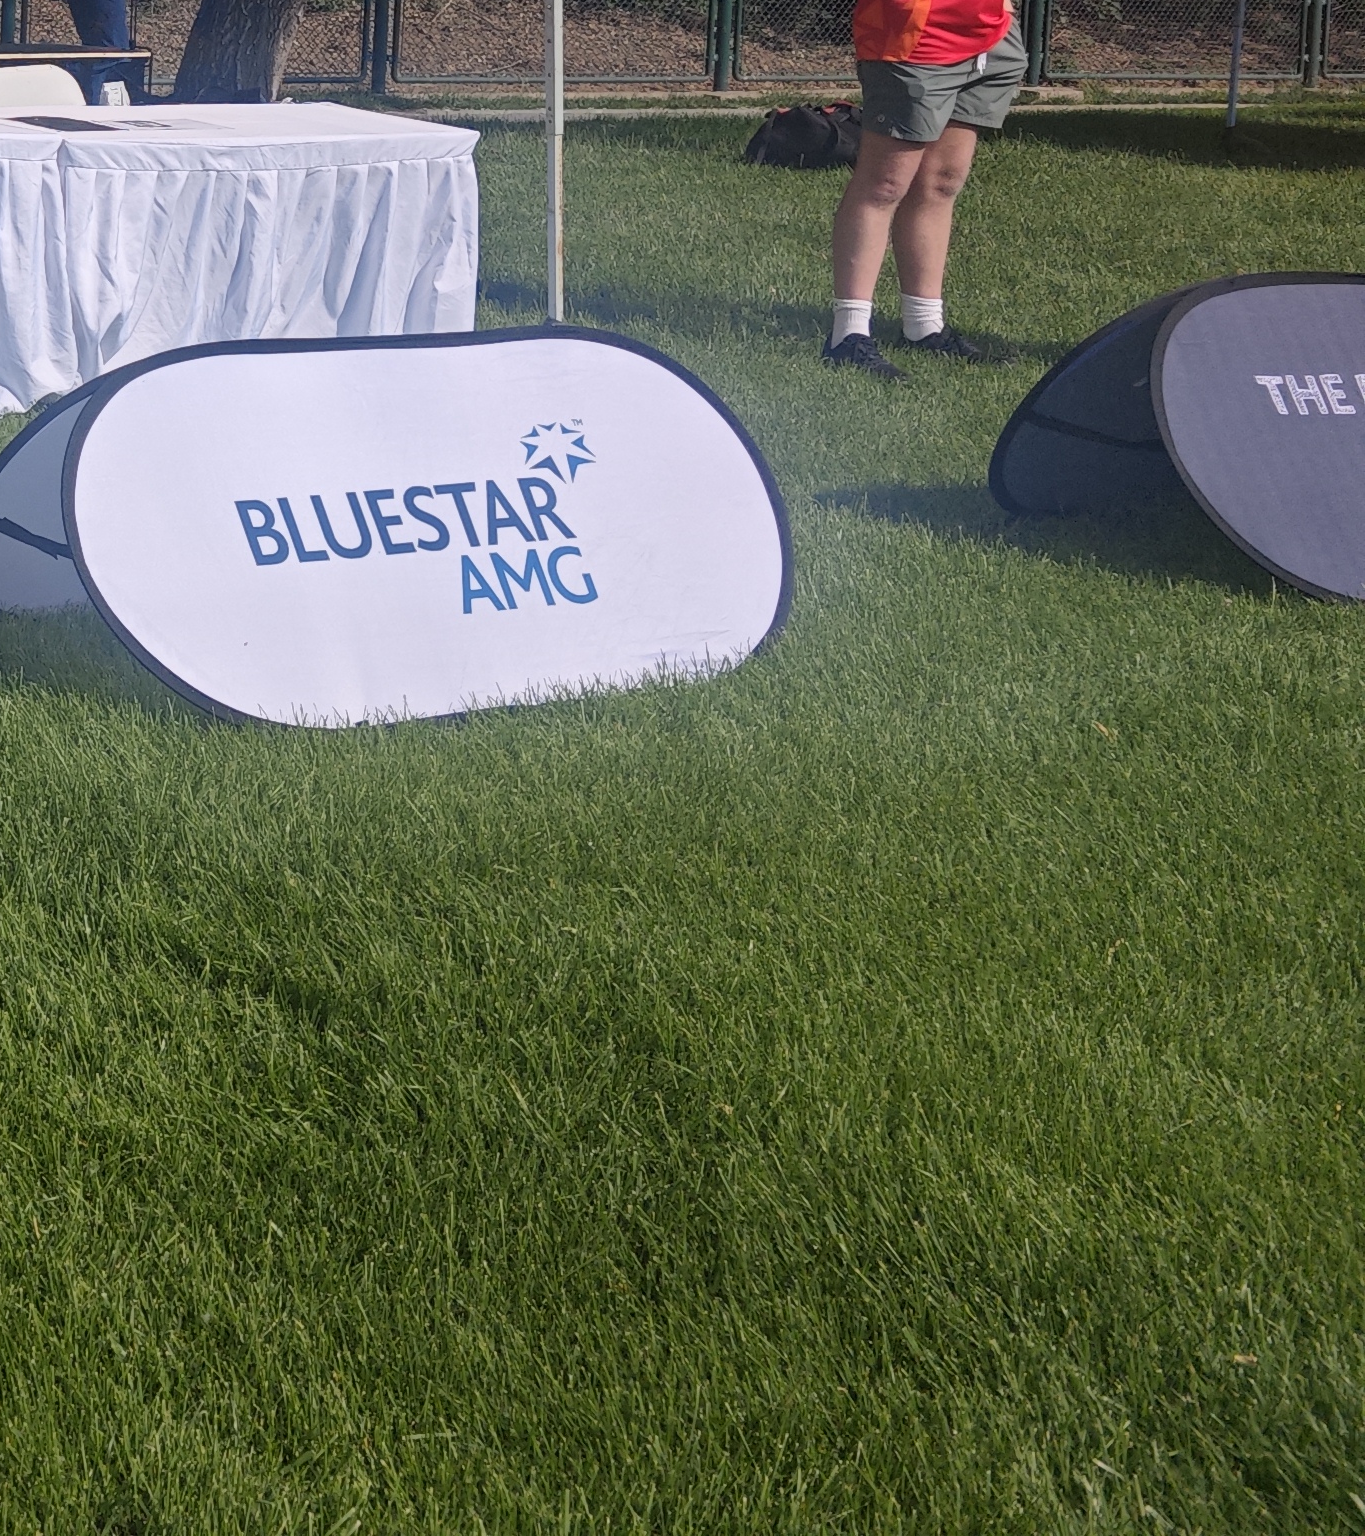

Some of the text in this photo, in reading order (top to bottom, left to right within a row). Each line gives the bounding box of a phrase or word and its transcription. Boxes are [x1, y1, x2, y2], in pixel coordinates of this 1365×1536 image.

[1254, 374, 1357, 415] THE
[234, 476, 577, 566] BLUESTAR
[461, 546, 598, 614] AMG
